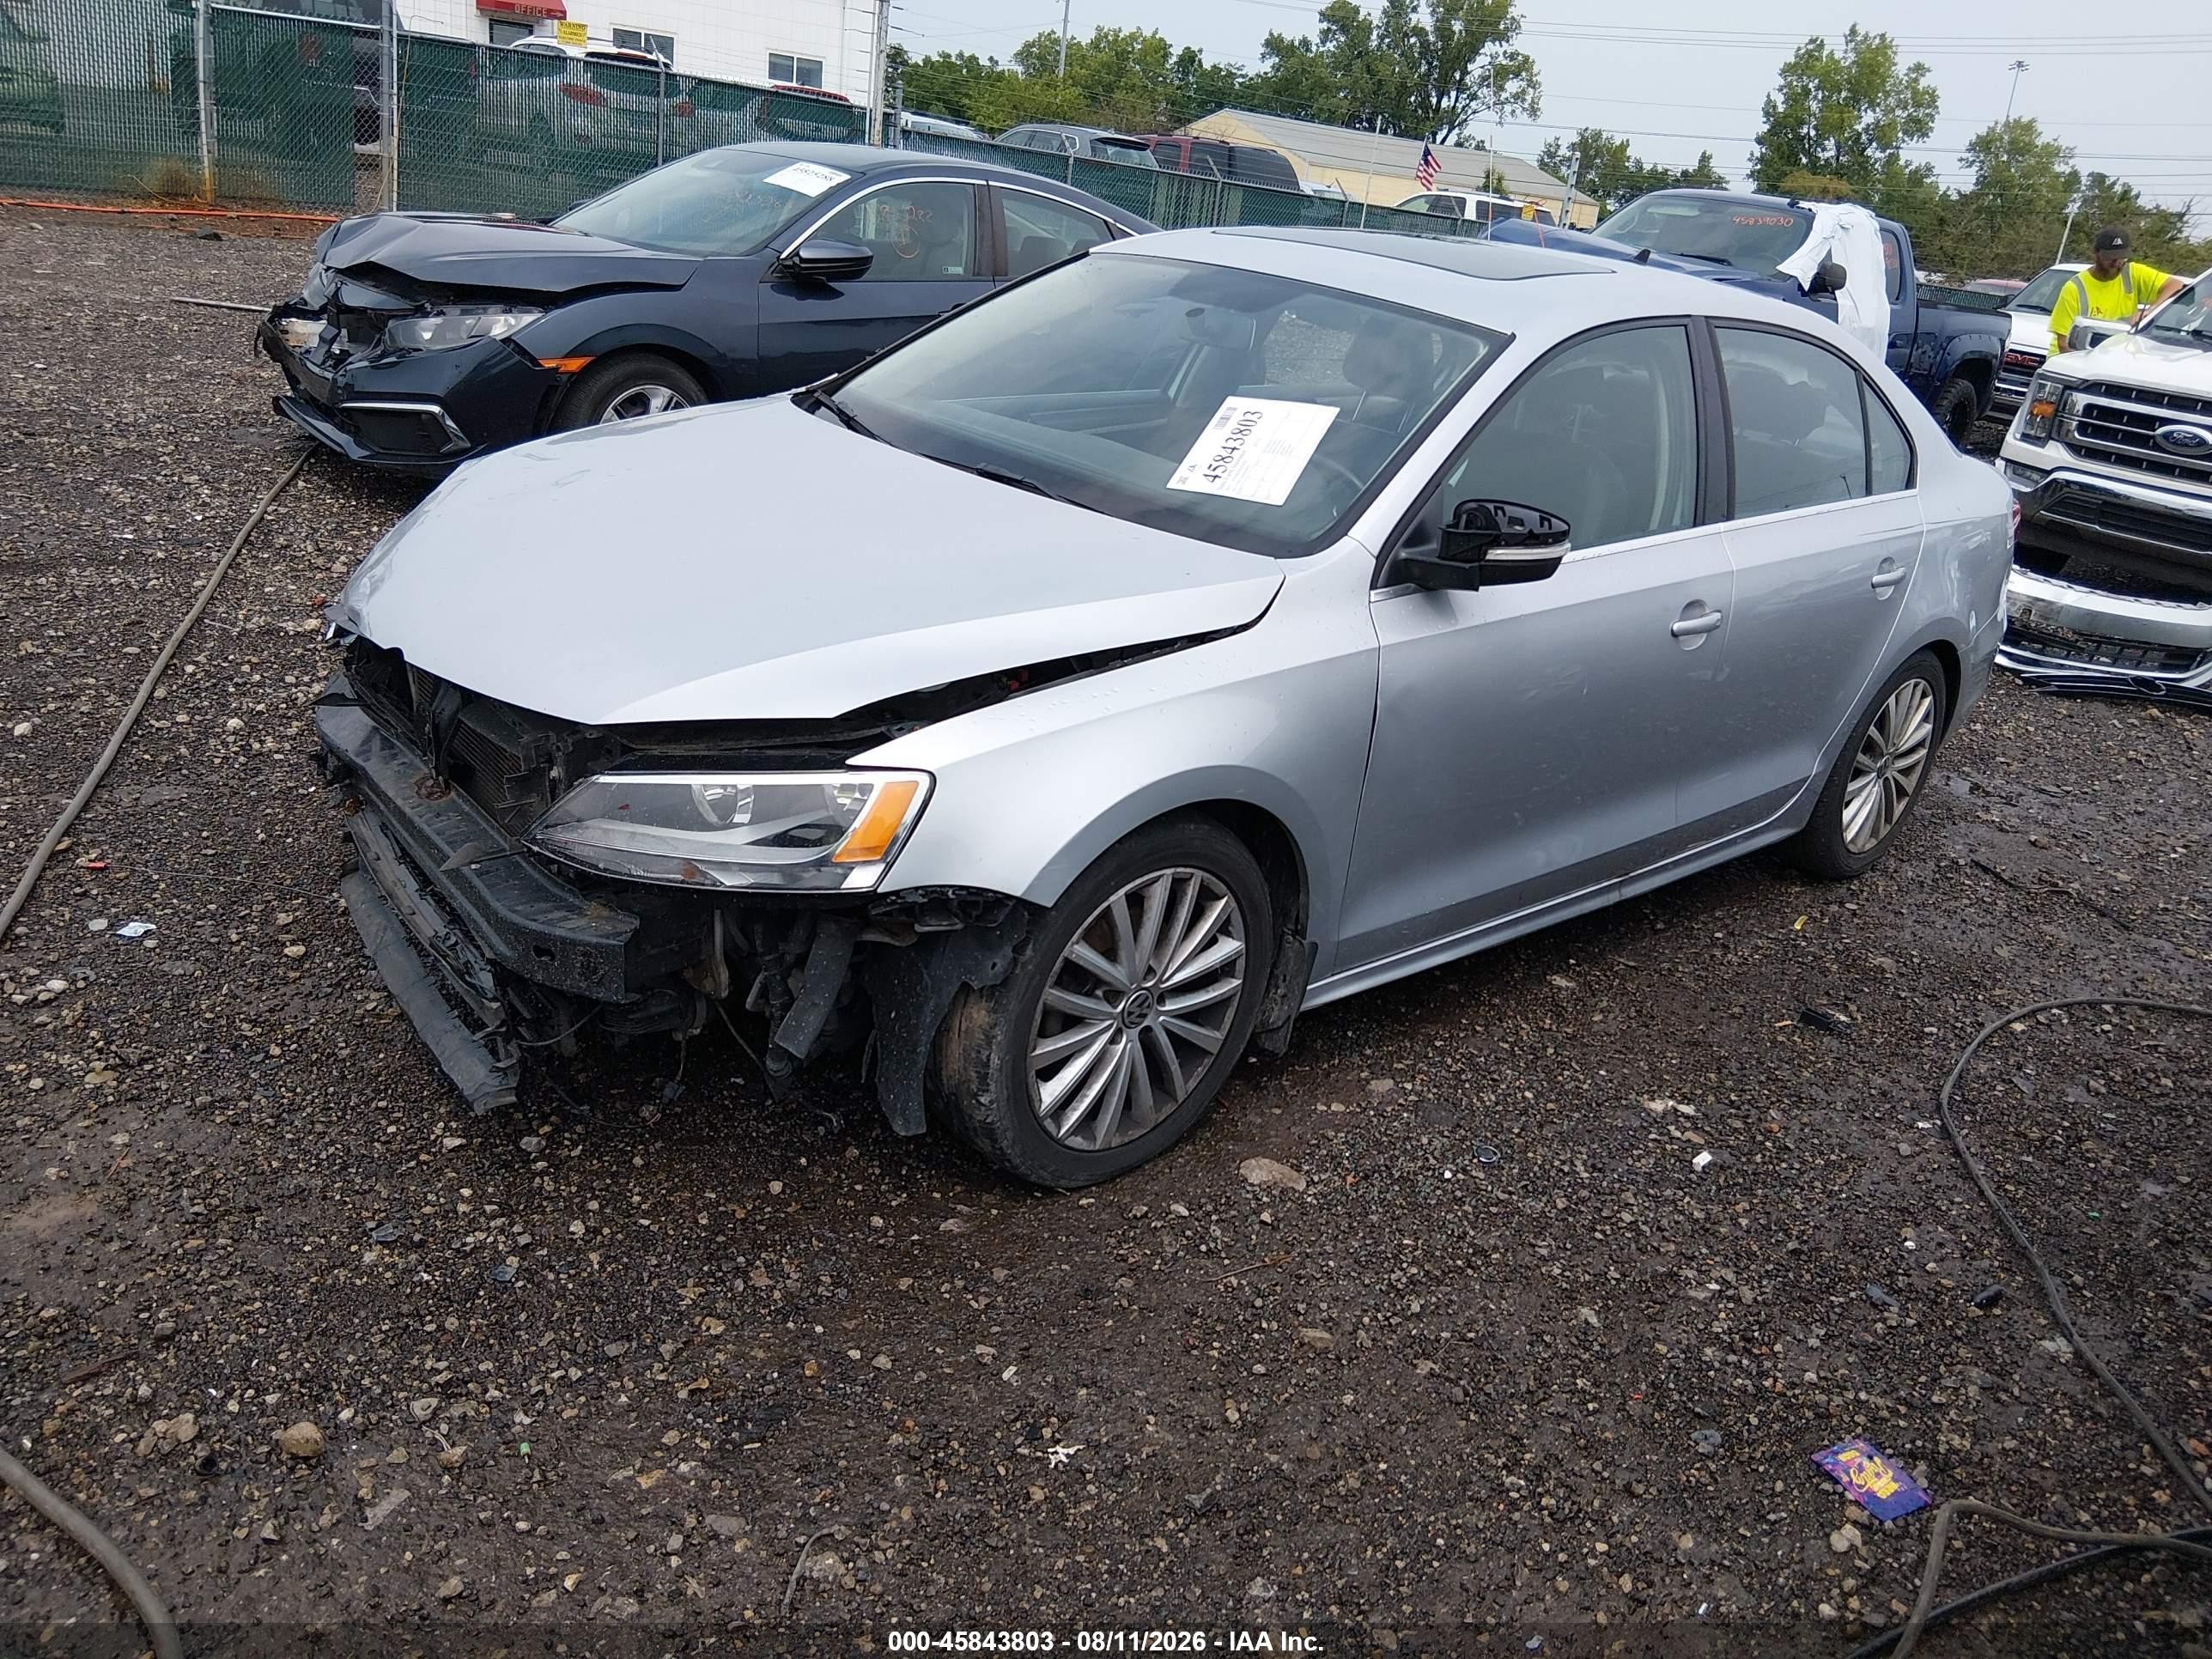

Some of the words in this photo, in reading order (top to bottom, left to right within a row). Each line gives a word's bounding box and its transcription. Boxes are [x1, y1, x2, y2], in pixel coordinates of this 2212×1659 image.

[514, 4, 548, 17] OFFICE
[559, 21, 586, 31] WARNING
[2169, 431, 2200, 447] Ford
[1202, 410, 1263, 483] 45843803
